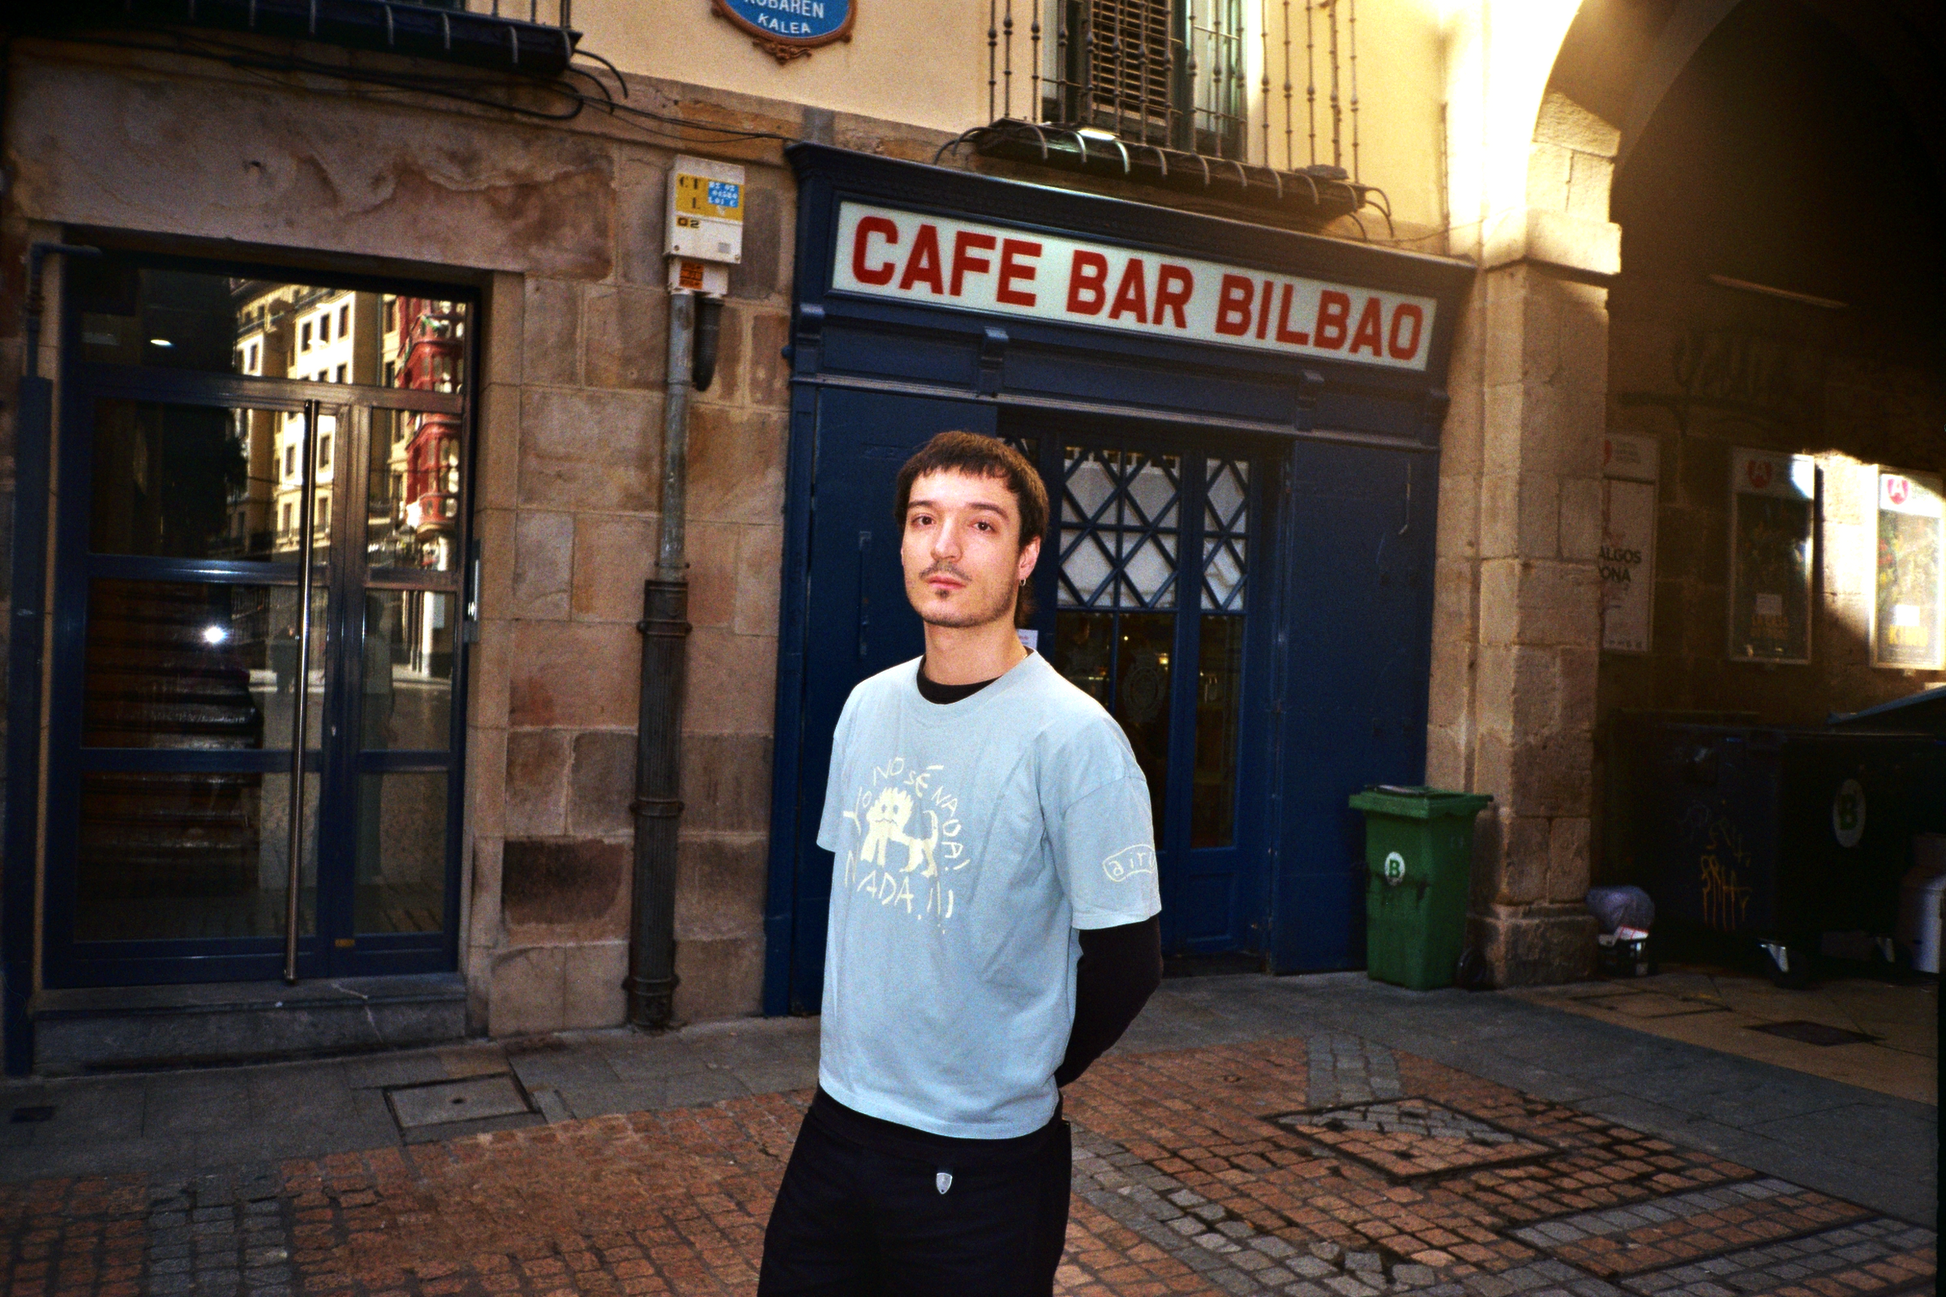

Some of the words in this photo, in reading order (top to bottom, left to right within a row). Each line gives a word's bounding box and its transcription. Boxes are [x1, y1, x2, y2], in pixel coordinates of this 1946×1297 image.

[758, 13, 811, 34] KALEA
[852, 215, 1043, 308] CAFE
[1066, 249, 1194, 329] BAR
[1215, 273, 1424, 361] BILBAO
[873, 756, 905, 787] NO
[1840, 794, 1858, 830] B
[1389, 859, 1400, 878] B
